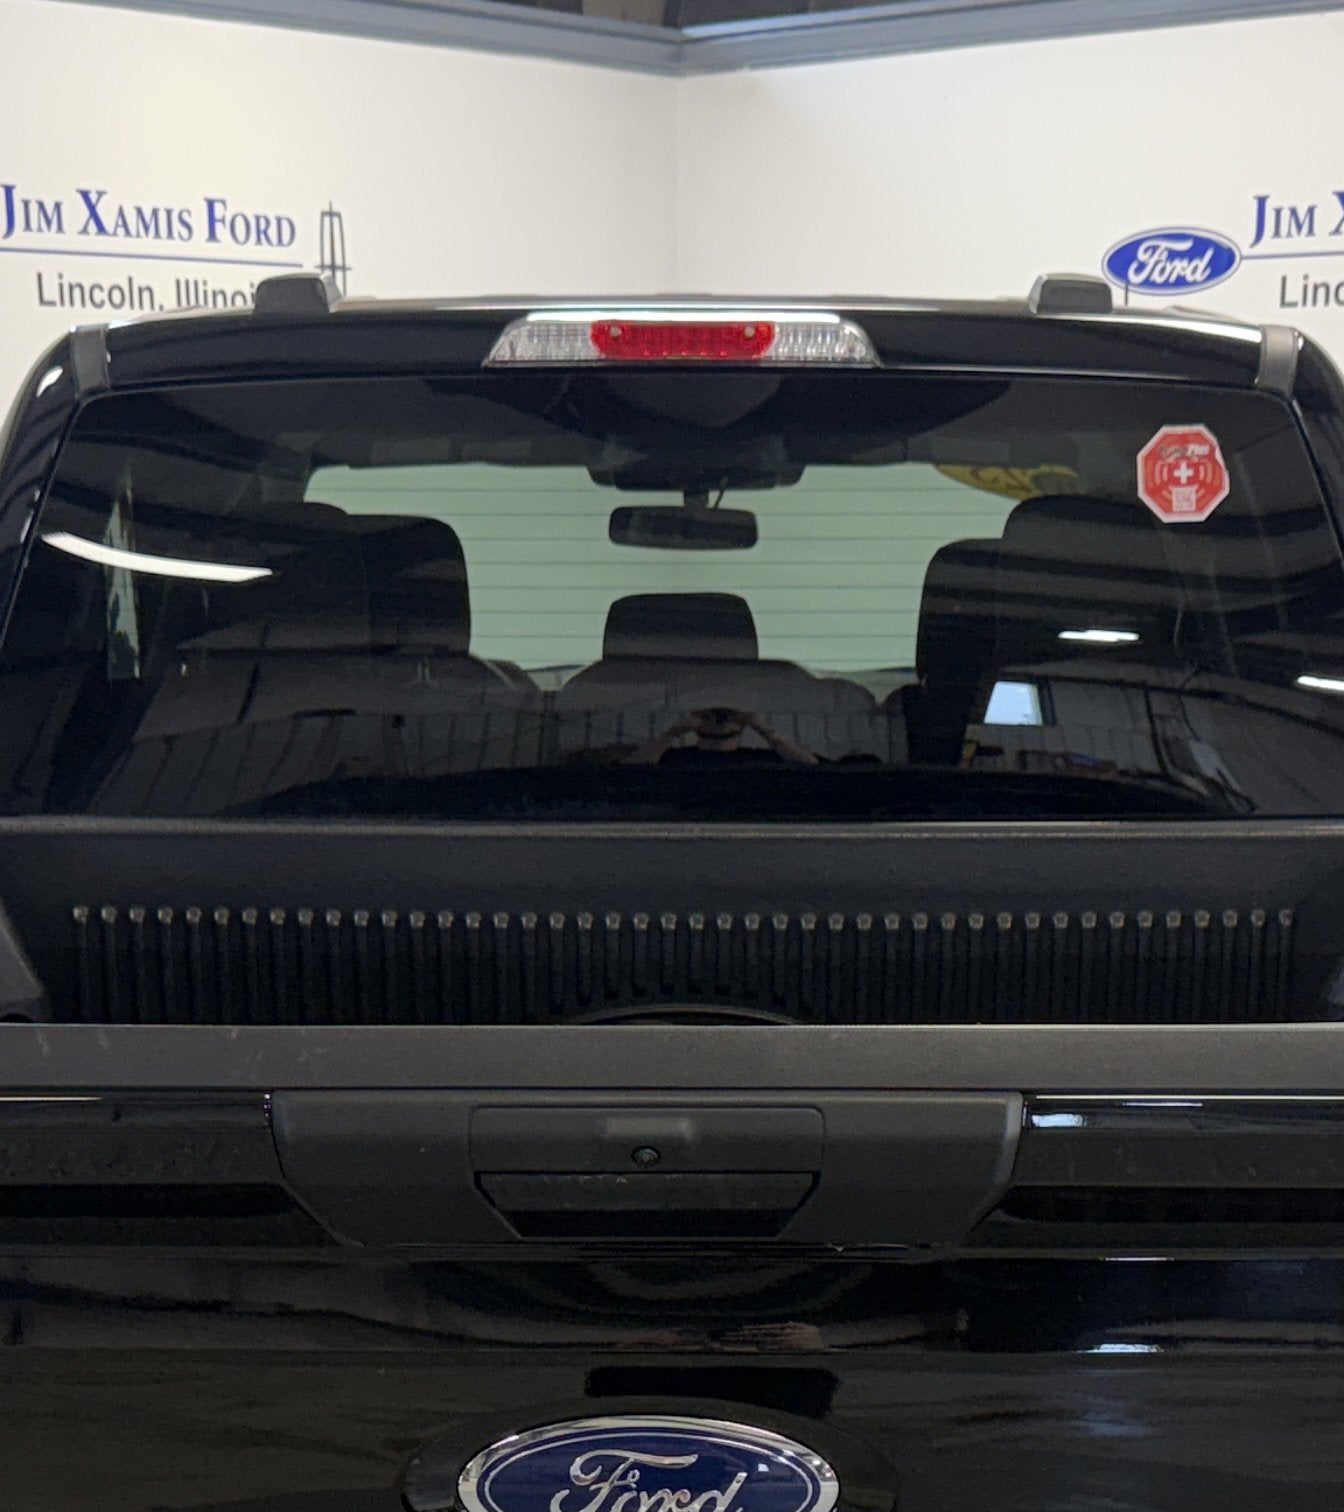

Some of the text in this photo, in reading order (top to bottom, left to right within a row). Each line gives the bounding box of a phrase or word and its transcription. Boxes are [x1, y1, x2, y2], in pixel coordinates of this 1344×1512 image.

[0, 184, 296, 247] JIM XAMIS FORD
[1250, 194, 1317, 248] JIM
[1126, 238, 1212, 285] Ford
[37, 272, 257, 312] Lincoln, Illinoi
